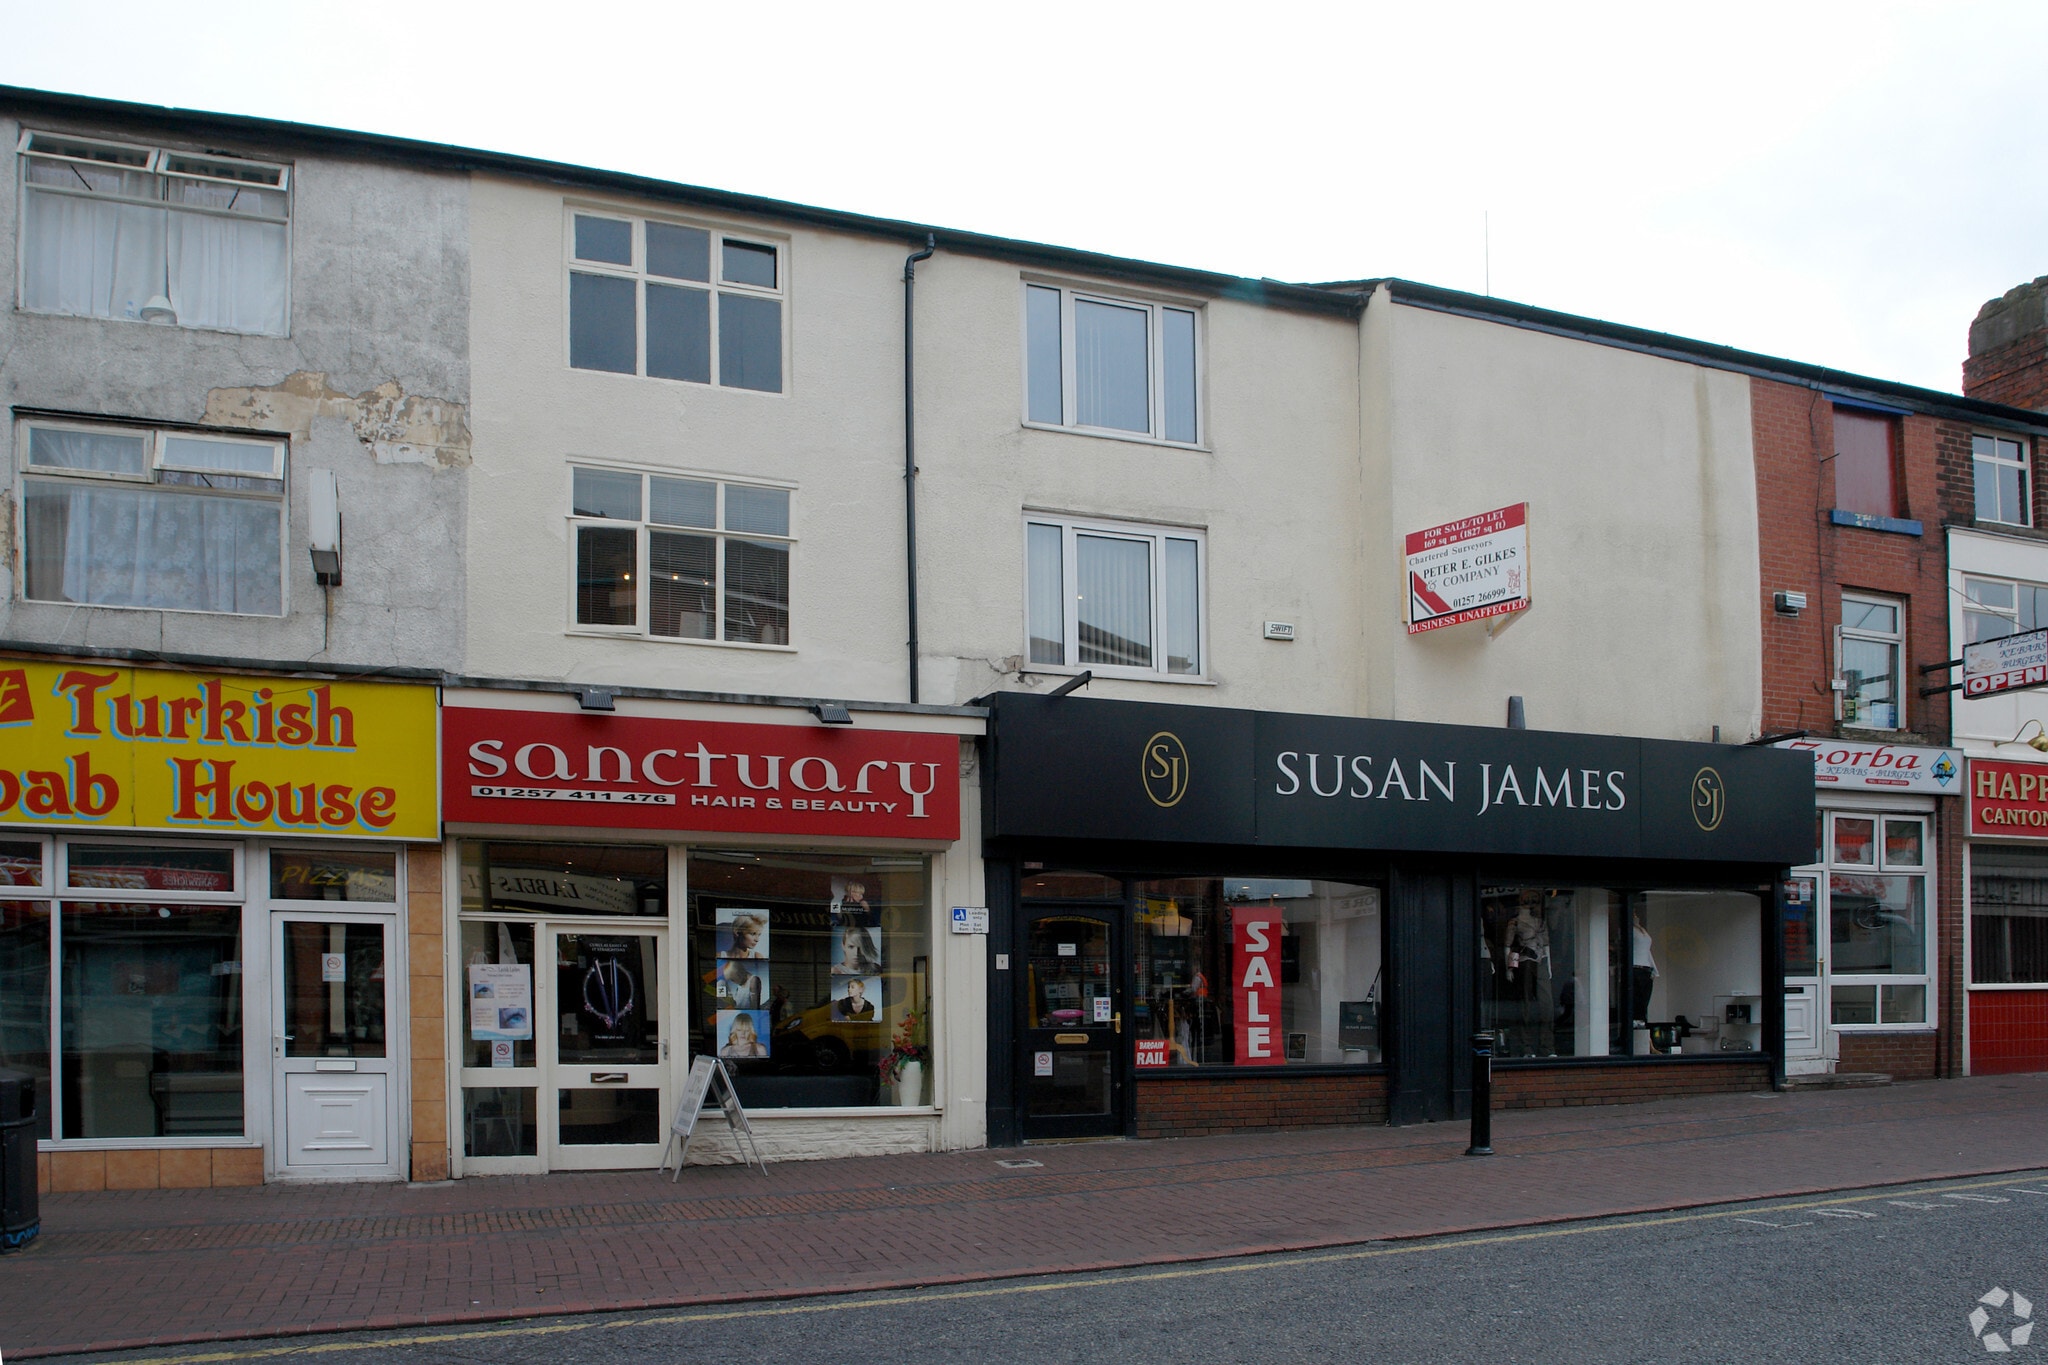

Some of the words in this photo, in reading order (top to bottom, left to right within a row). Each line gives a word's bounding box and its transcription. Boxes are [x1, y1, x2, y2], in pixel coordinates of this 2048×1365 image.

[1424, 528, 1442, 539] FOR
[1444, 517, 1485, 536] SALE/TO
[1487, 510, 1505, 521] LET
[1424, 538, 1436, 549] 169
[1438, 537, 1447, 545] sq
[1460, 527, 1481, 540] (1827
[1483, 526, 1492, 535] sq
[1495, 519, 1506, 531] ft)
[1408, 549, 1449, 566] Chartered
[1451, 539, 1493, 556] Surveyors
[1423, 562, 1457, 579] PETER
[1462, 559, 1472, 570] E.
[1475, 547, 1516, 567] GILKES
[1425, 580, 1437, 593] &
[1443, 565, 1500, 588] COMPANY
[1453, 595, 1475, 608] 01257
[1478, 587, 1506, 603] 266999
[1409, 616, 1456, 634] BUSINESS
[1459, 600, 1527, 622] UNAFFECTED
[1997, 632, 2046, 649] PIZZAS
[2000, 641, 2047, 658] KEBABS
[2002, 652, 2047, 669] BURGERS
[1970, 666, 2044, 693] OPEN
[53, 670, 357, 752] Turkish
[1275, 751, 1457, 803] SUSAN
[1476, 763, 1627, 817] JAMES
[1826, 765, 1869, 777] KEBABS
[1875, 769, 1922, 781] BURGERS
[1976, 770, 2048, 802] HAPP
[166, 757, 397, 831] House
[478, 787, 557, 798] 01257
[568, 791, 612, 800] 411
[623, 793, 668, 803] 476
[690, 794, 756, 809] HAIR
[765, 797, 783, 809] &
[791, 799, 898, 813] BEAUTY
[281, 865, 385, 887] PIZZAS
[1242, 921, 1275, 1058] SALE
[1136, 1051, 1167, 1065] RAIL
[1139, 1041, 1165, 1050] BARGAIN
